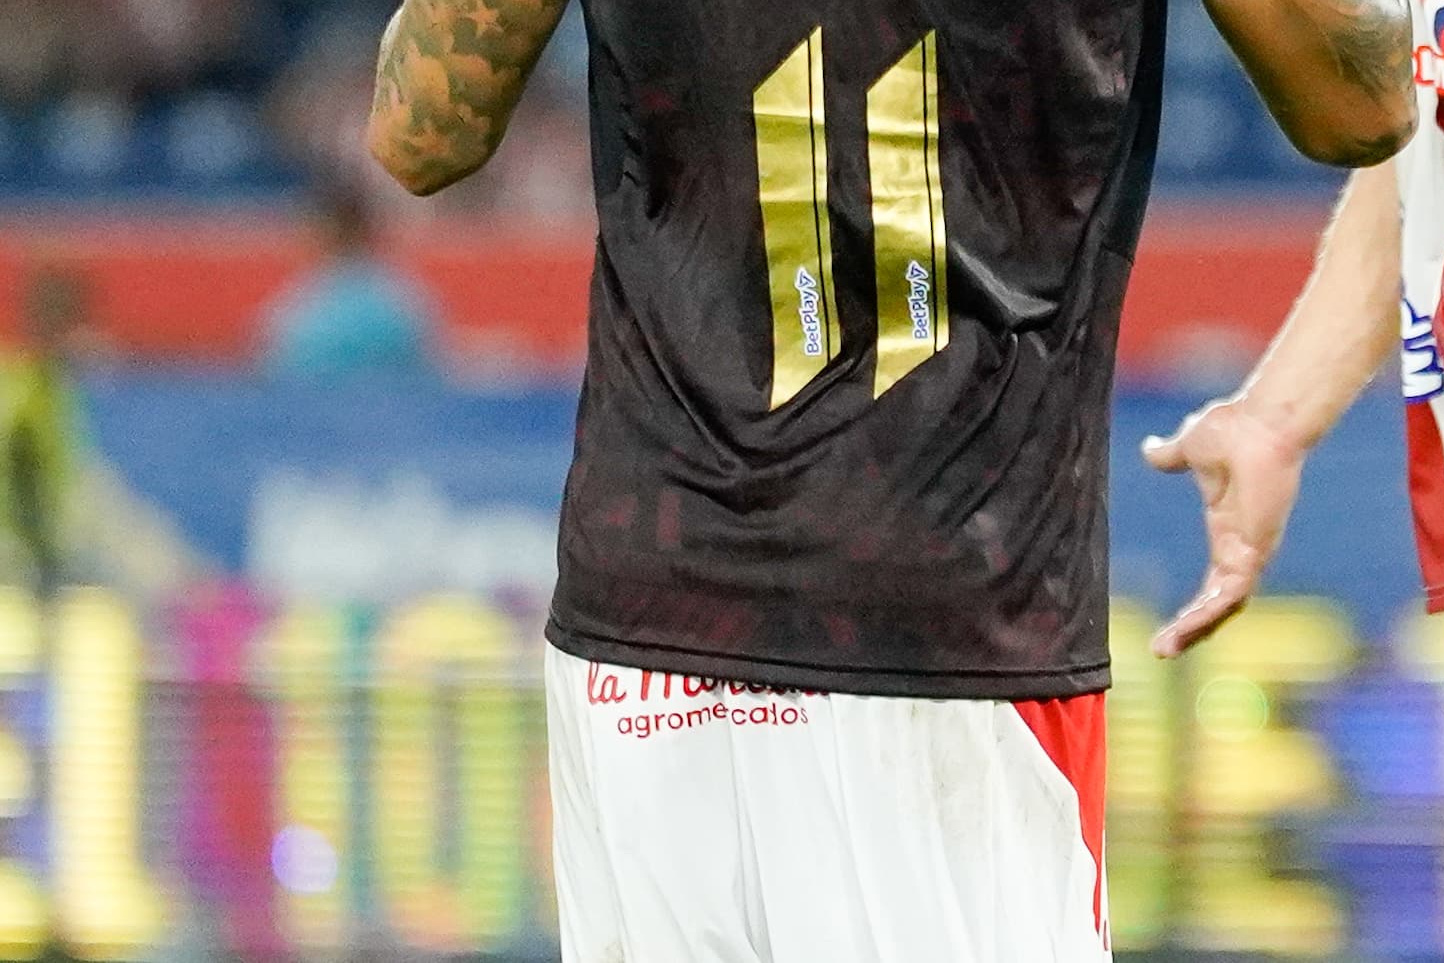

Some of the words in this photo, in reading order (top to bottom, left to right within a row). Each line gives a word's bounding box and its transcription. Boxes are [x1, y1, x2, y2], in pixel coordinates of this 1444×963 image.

[752, 24, 950, 413] 11
[800, 284, 822, 355] BetPlay
[908, 278, 930, 341] BetPlay
